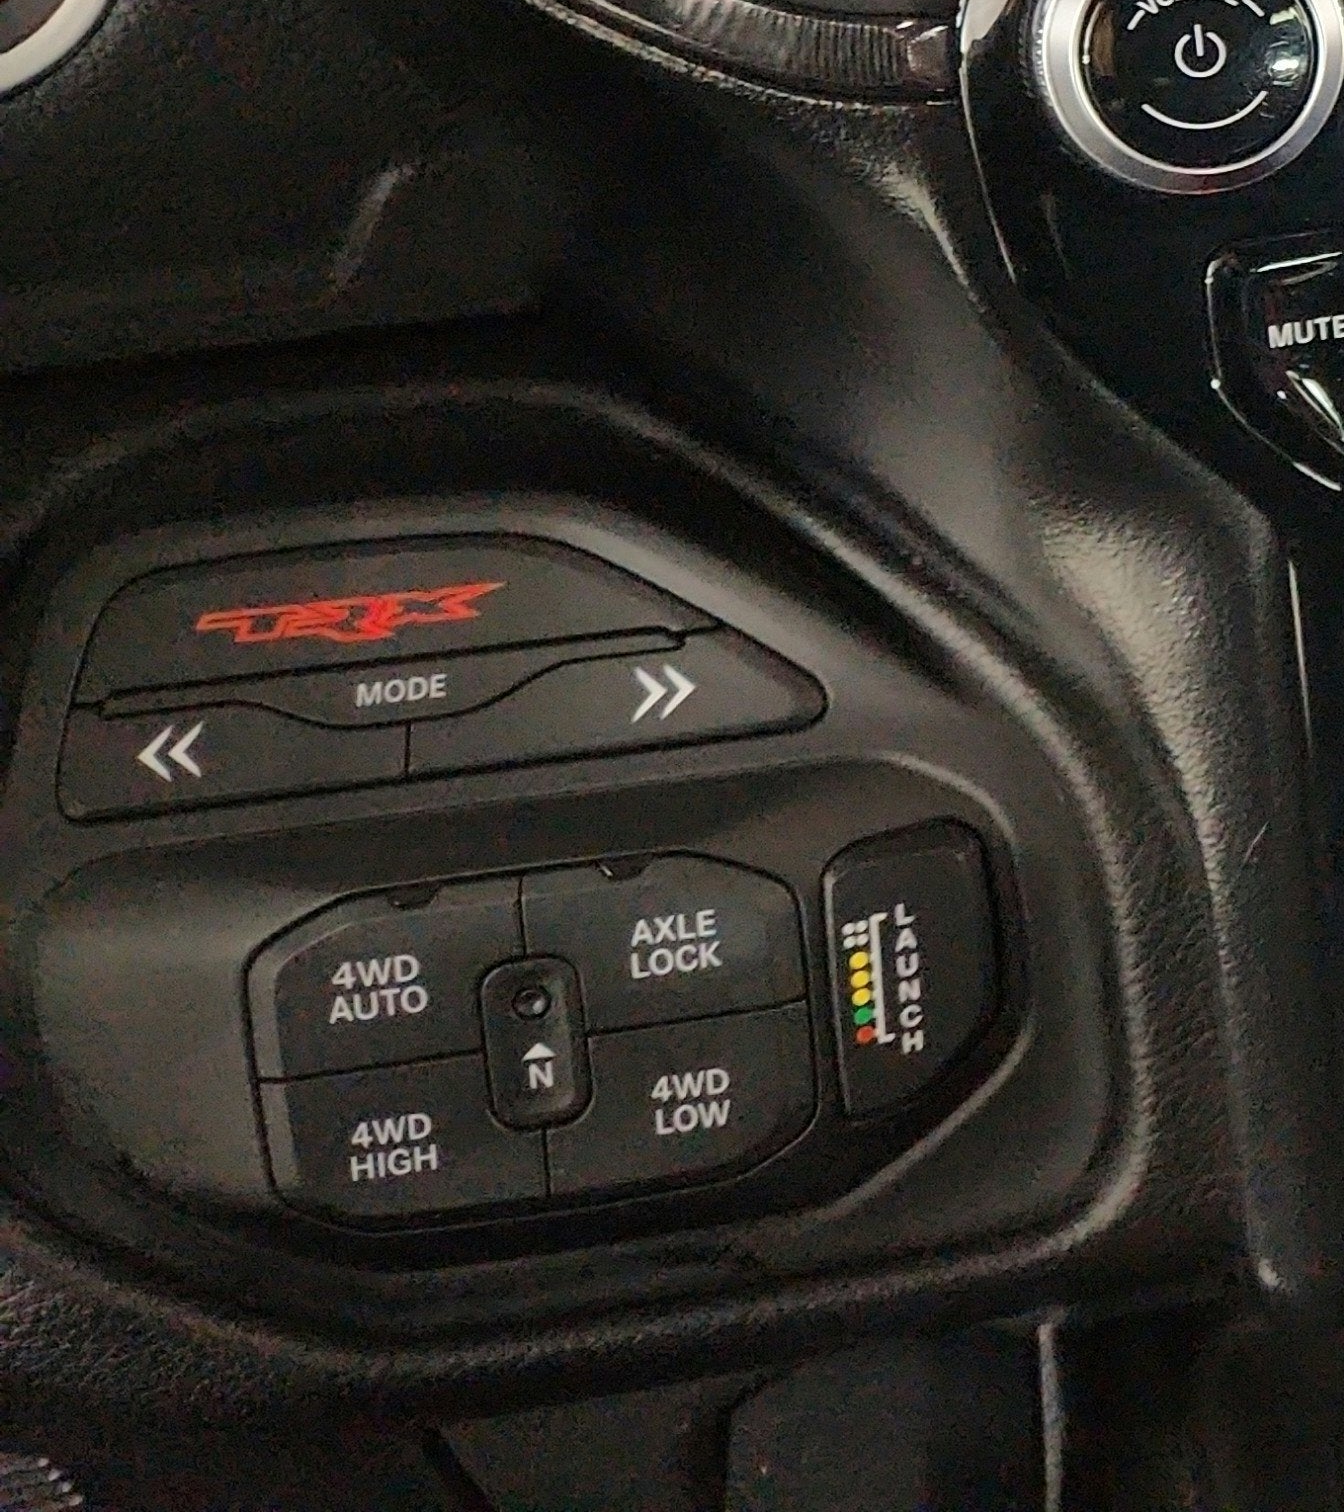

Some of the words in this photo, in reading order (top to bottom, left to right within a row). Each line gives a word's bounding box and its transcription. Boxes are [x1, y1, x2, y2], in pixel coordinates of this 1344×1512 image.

[355, 673, 448, 708] MODE
[629, 909, 719, 949] AXLE
[331, 954, 420, 991] 4WD
[630, 940, 722, 981] LOCK
[328, 986, 430, 1025] AUTO
[528, 1062, 555, 1089] N
[651, 1067, 731, 1104] 4WD
[351, 1113, 432, 1150] 4WD
[654, 1099, 732, 1136] LOW
[350, 1143, 438, 1182] HIGH
